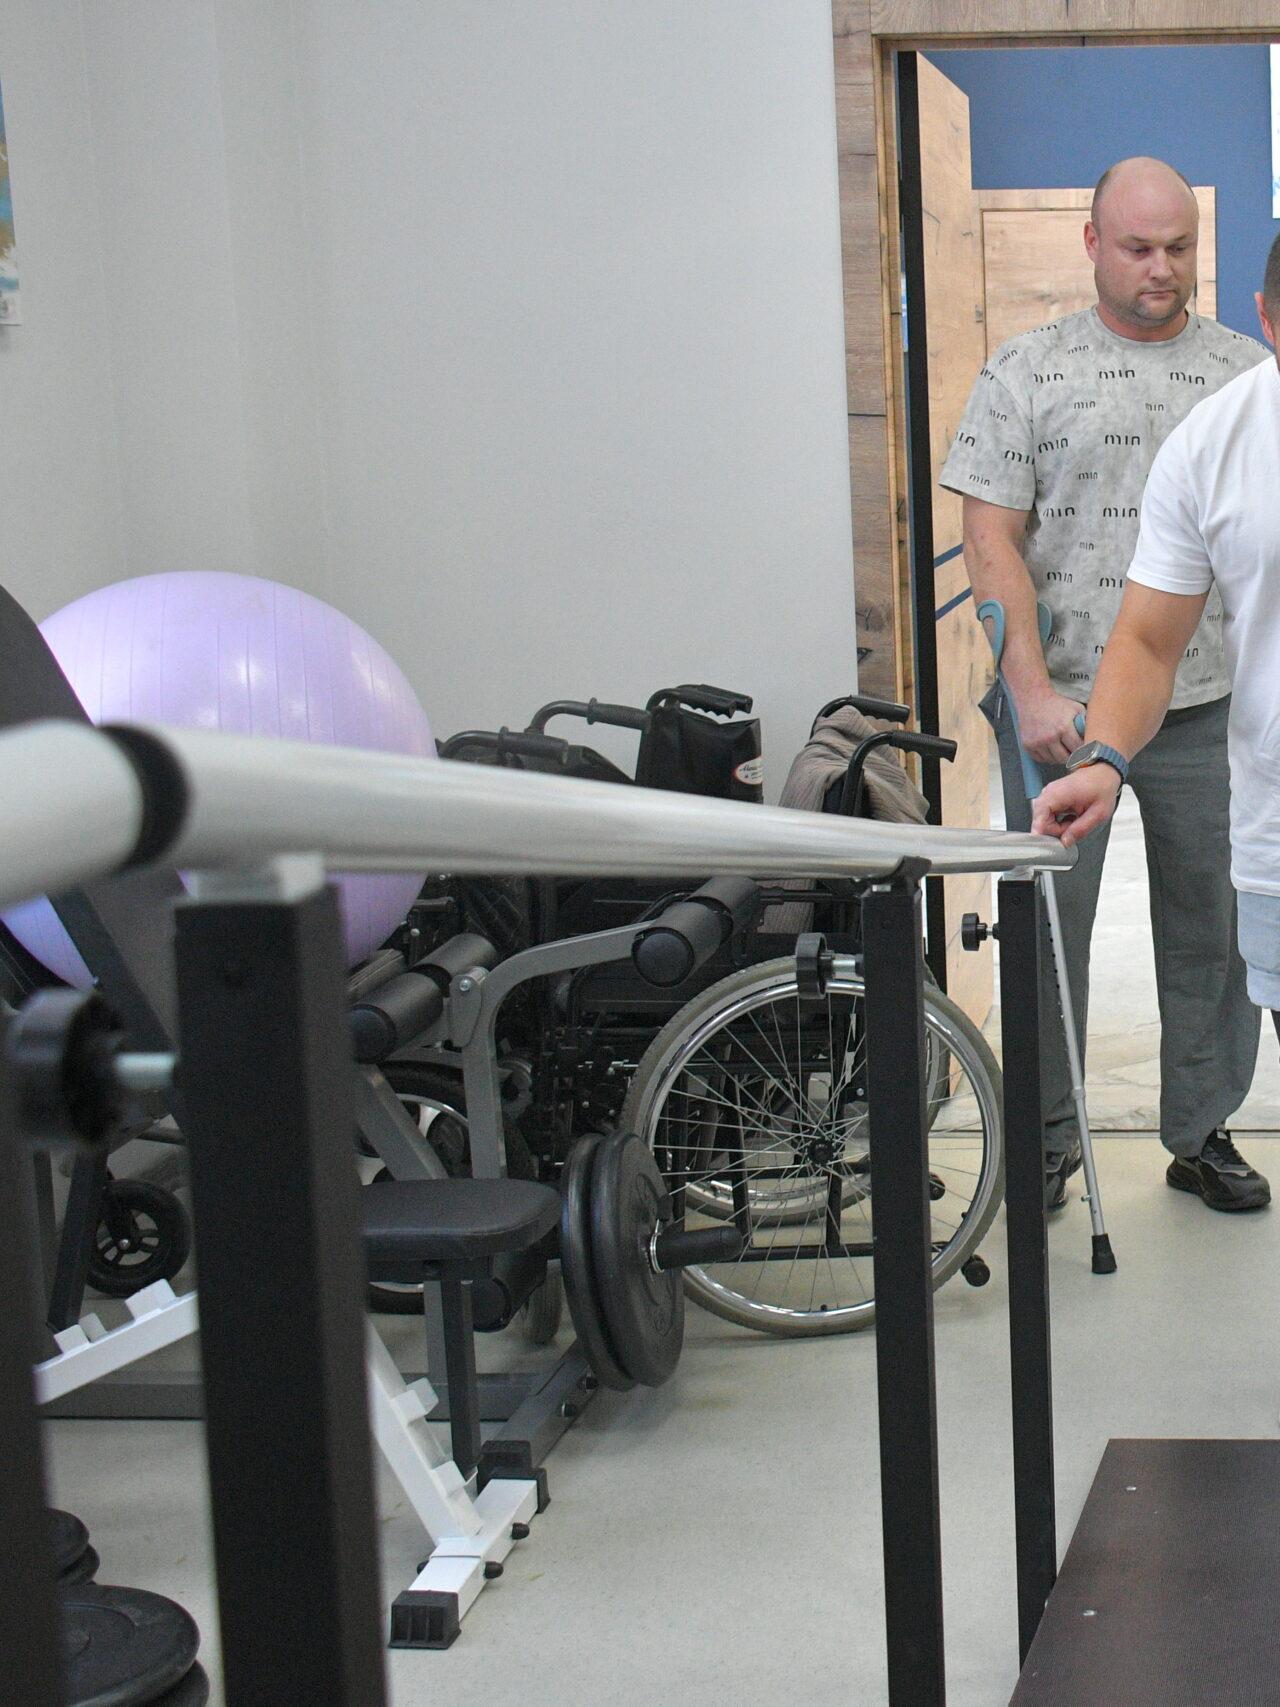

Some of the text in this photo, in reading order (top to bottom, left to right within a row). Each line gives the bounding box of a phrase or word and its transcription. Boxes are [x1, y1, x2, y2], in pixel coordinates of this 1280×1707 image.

[1099, 369, 1136, 380] min
[1170, 371, 1206, 386] min
[1038, 437, 1069, 453] min
[1105, 434, 1141, 446] min
[1103, 507, 1138, 518] min
[1099, 577, 1124, 589] mi
